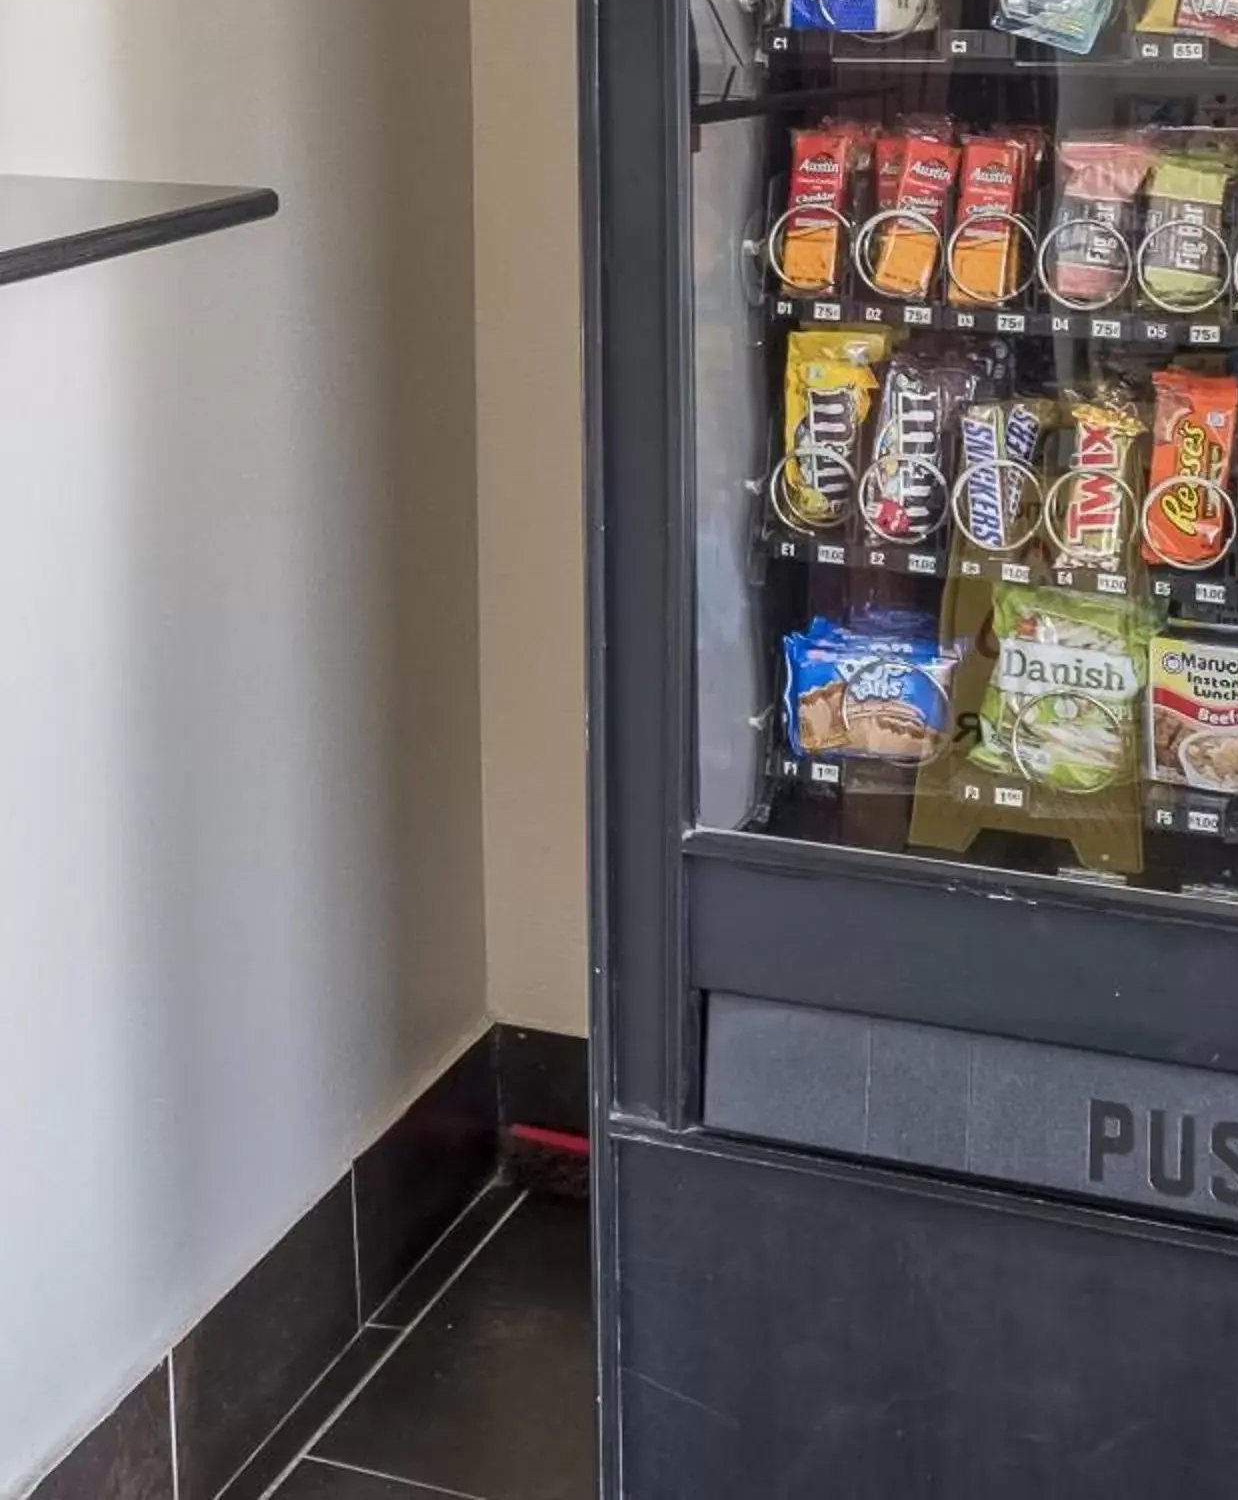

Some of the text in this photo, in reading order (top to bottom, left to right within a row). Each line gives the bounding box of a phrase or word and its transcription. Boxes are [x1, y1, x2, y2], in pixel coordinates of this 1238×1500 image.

[799, 157, 838, 173] Austin
[911, 161, 950, 181] Austin
[970, 167, 1013, 185] Austin
[1086, 235, 1118, 264] Fig
[1175, 203, 1209, 270] Fig Bar
[963, 417, 1005, 547] SNICKERS
[1068, 422, 1119, 546] TWIX
[1160, 421, 1206, 536] Reese's
[1003, 648, 1126, 691] Danish
[1198, 707, 1235, 725] Beef
